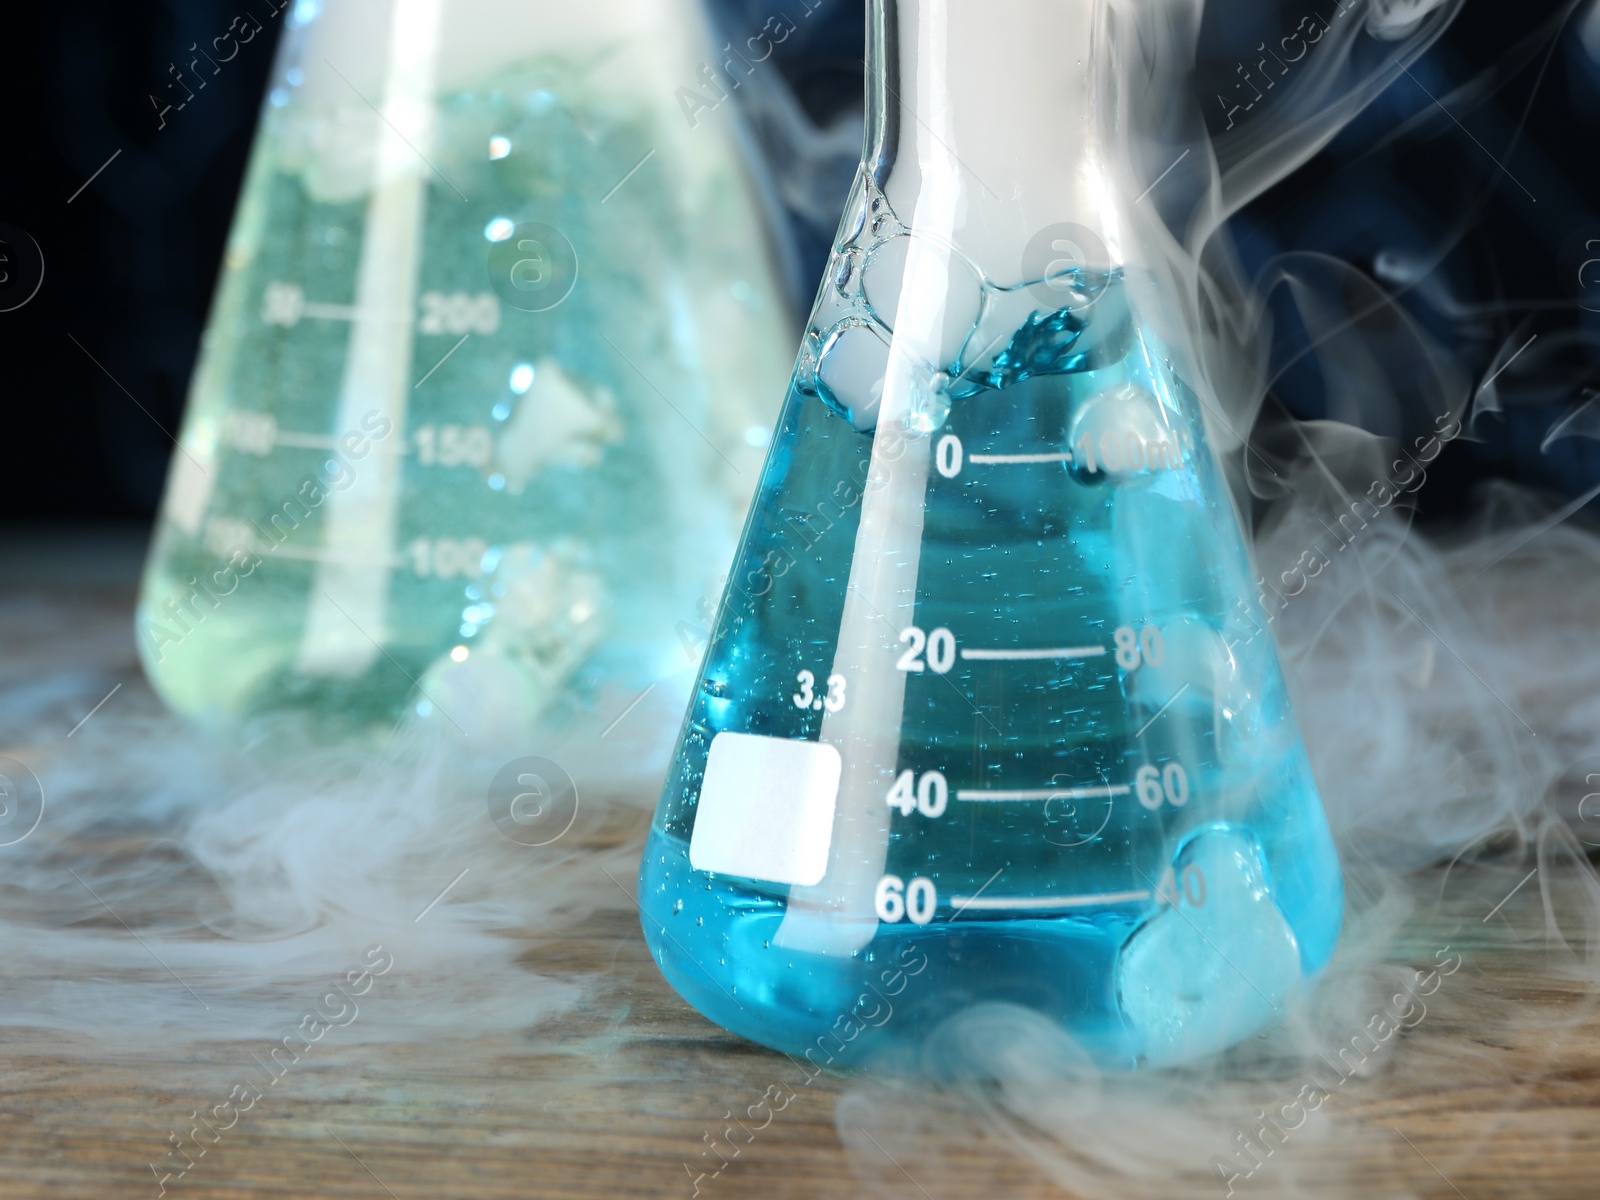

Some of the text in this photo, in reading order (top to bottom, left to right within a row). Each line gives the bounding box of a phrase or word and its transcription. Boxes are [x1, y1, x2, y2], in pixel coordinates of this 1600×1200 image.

[419, 291, 500, 336] 200
[413, 424, 495, 467] 150
[936, 429, 1184, 479] 0 100ml
[409, 535, 490, 579] 100
[896, 625, 1165, 673] 20 80
[793, 670, 847, 712] 3.3
[886, 762, 1190, 818] 40 60
[875, 863, 1206, 925] 60 40
